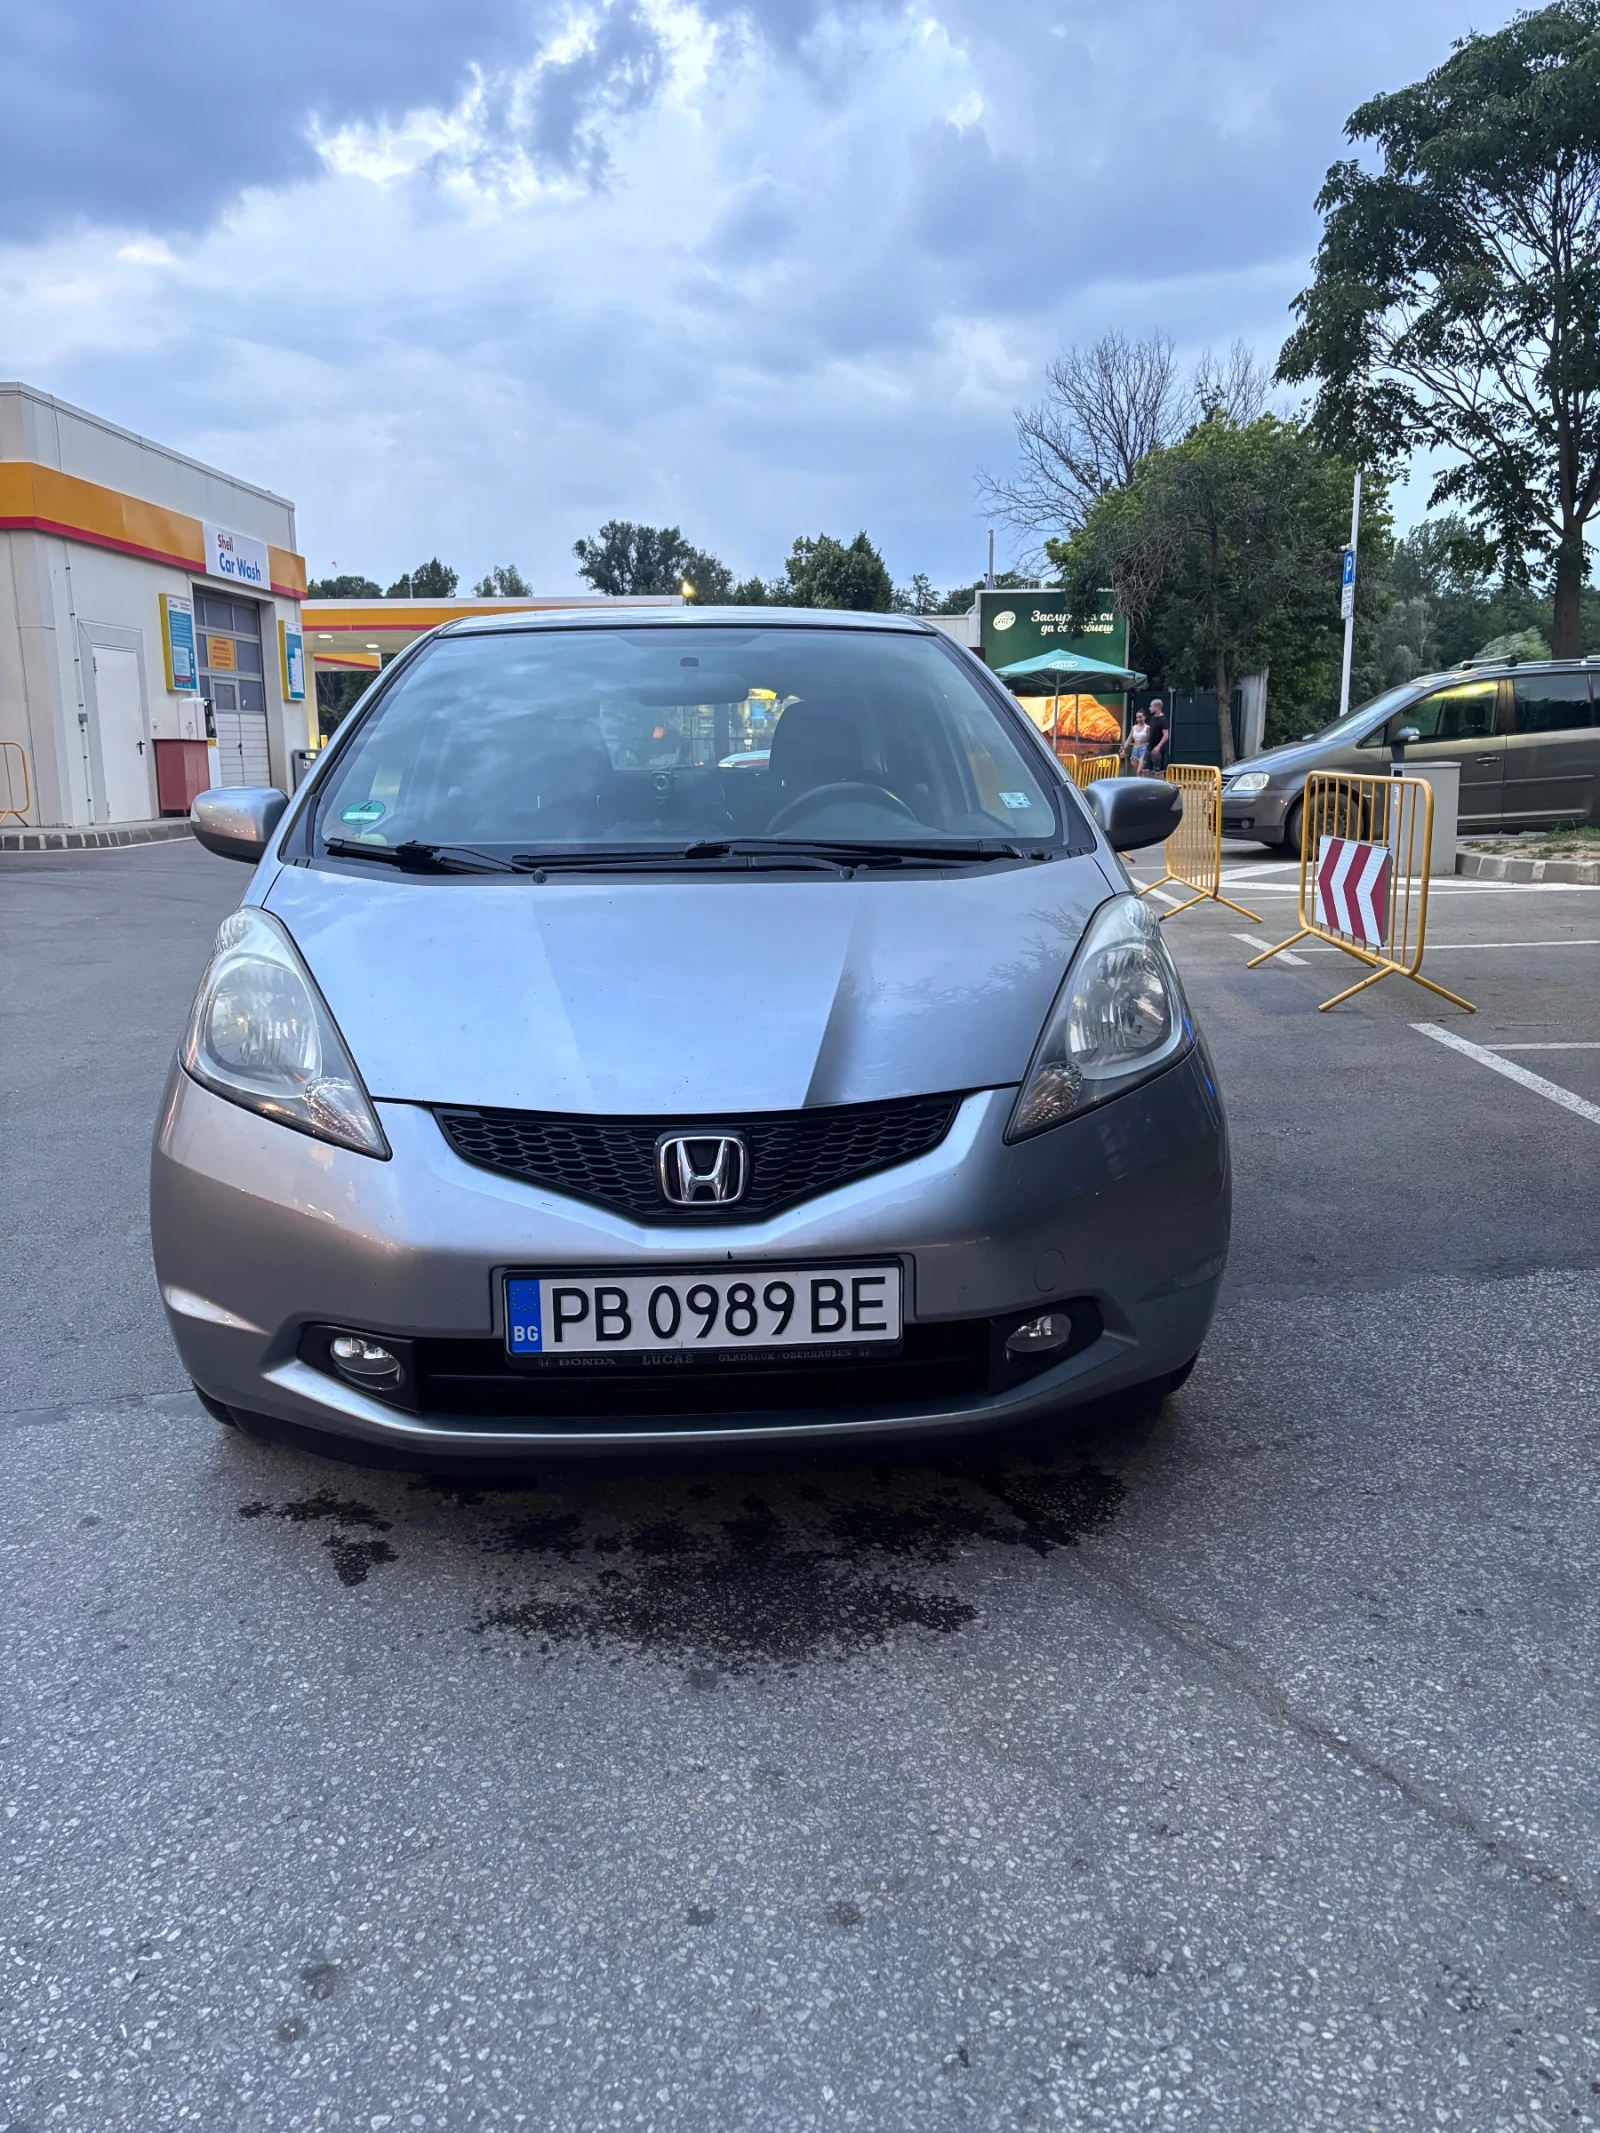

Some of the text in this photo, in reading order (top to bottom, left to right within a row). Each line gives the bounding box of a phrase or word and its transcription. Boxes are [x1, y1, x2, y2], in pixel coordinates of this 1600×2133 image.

[217, 533, 234, 552] Shell
[219, 552, 261, 582] Car Wash
[1346, 555, 1353, 581] P
[1030, 609, 1114, 625] Заслуа си
[1040, 624, 1055, 636] да
[551, 1275, 887, 1342] PB 0989 BE
[513, 1325, 539, 1342] BG
[558, 1358, 617, 1366] HONDA
[642, 1354, 694, 1365] LUCAS
